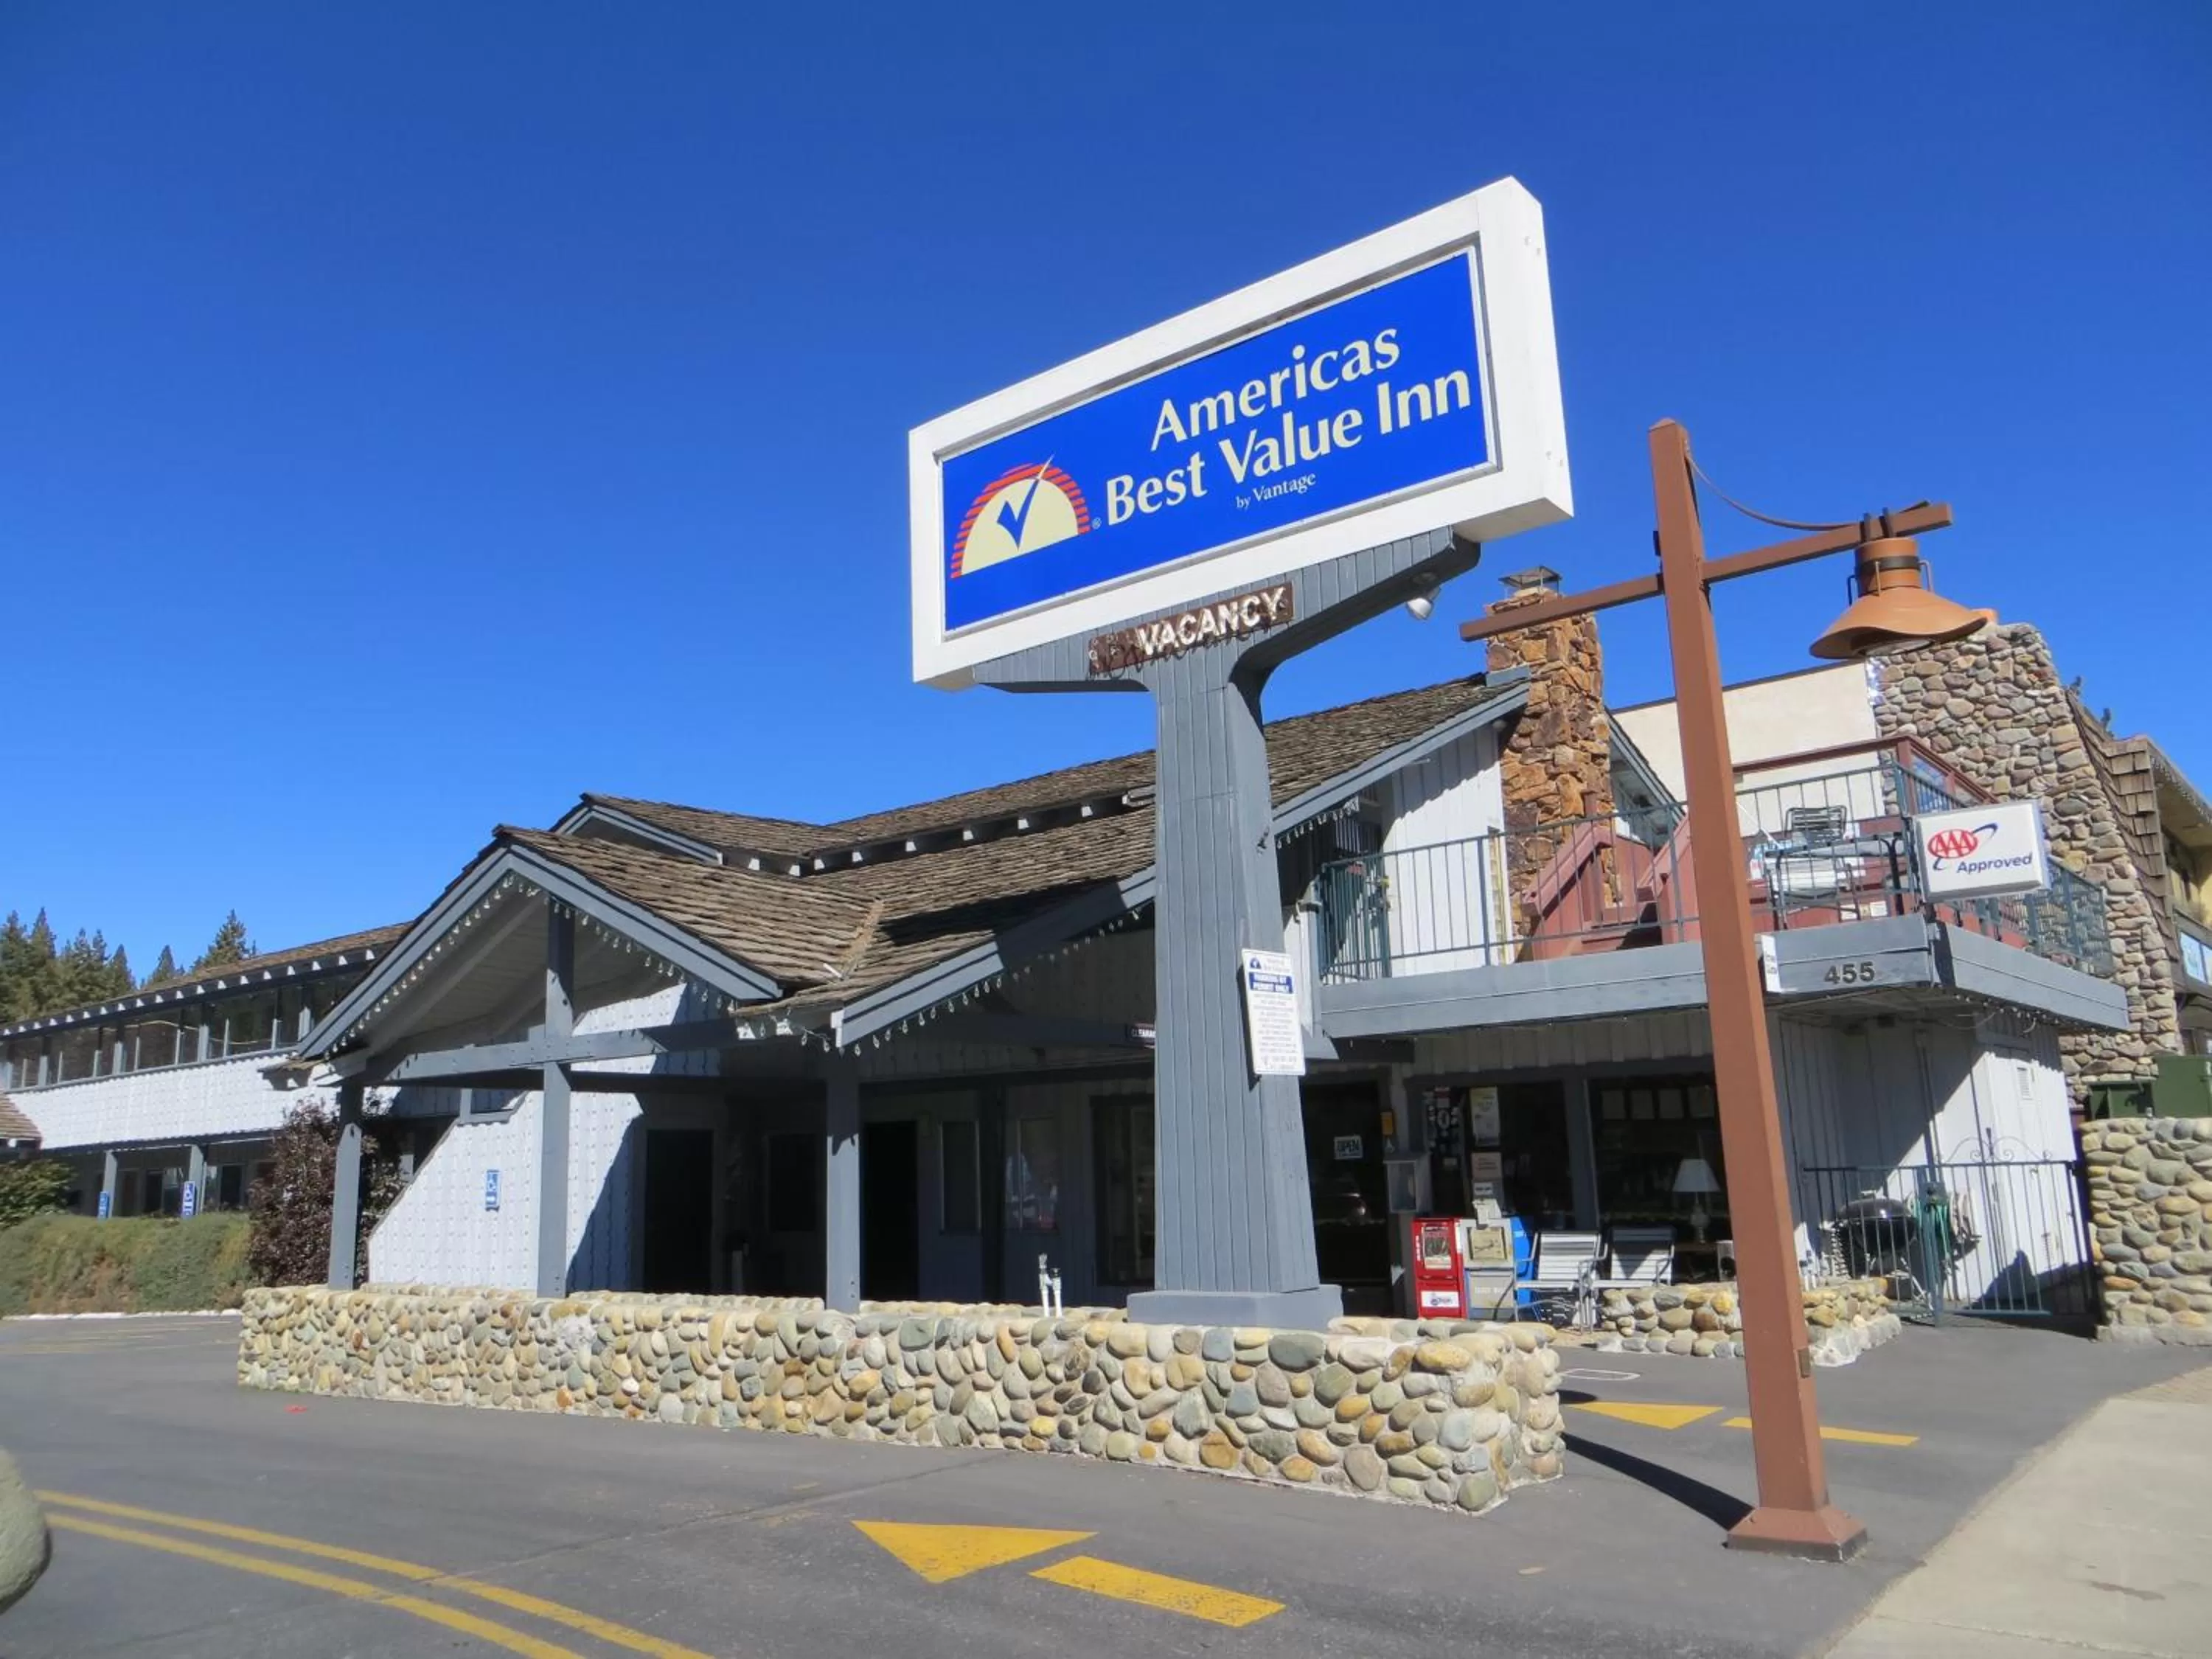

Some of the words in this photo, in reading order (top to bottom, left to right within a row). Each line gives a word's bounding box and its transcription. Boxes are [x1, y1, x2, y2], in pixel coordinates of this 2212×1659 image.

[1151, 328, 1399, 451] Americas
[1107, 451, 1207, 526] Best
[1218, 409, 1363, 484] Value
[1377, 370, 1471, 434] Inn
[1235, 495, 1250, 509] by
[1253, 473, 1316, 501] Vantage
[1135, 586, 1285, 655] VACANCY
[1933, 830, 1975, 857] AAA
[1956, 852, 2034, 874] Approved
[1824, 961, 1875, 984] 455
